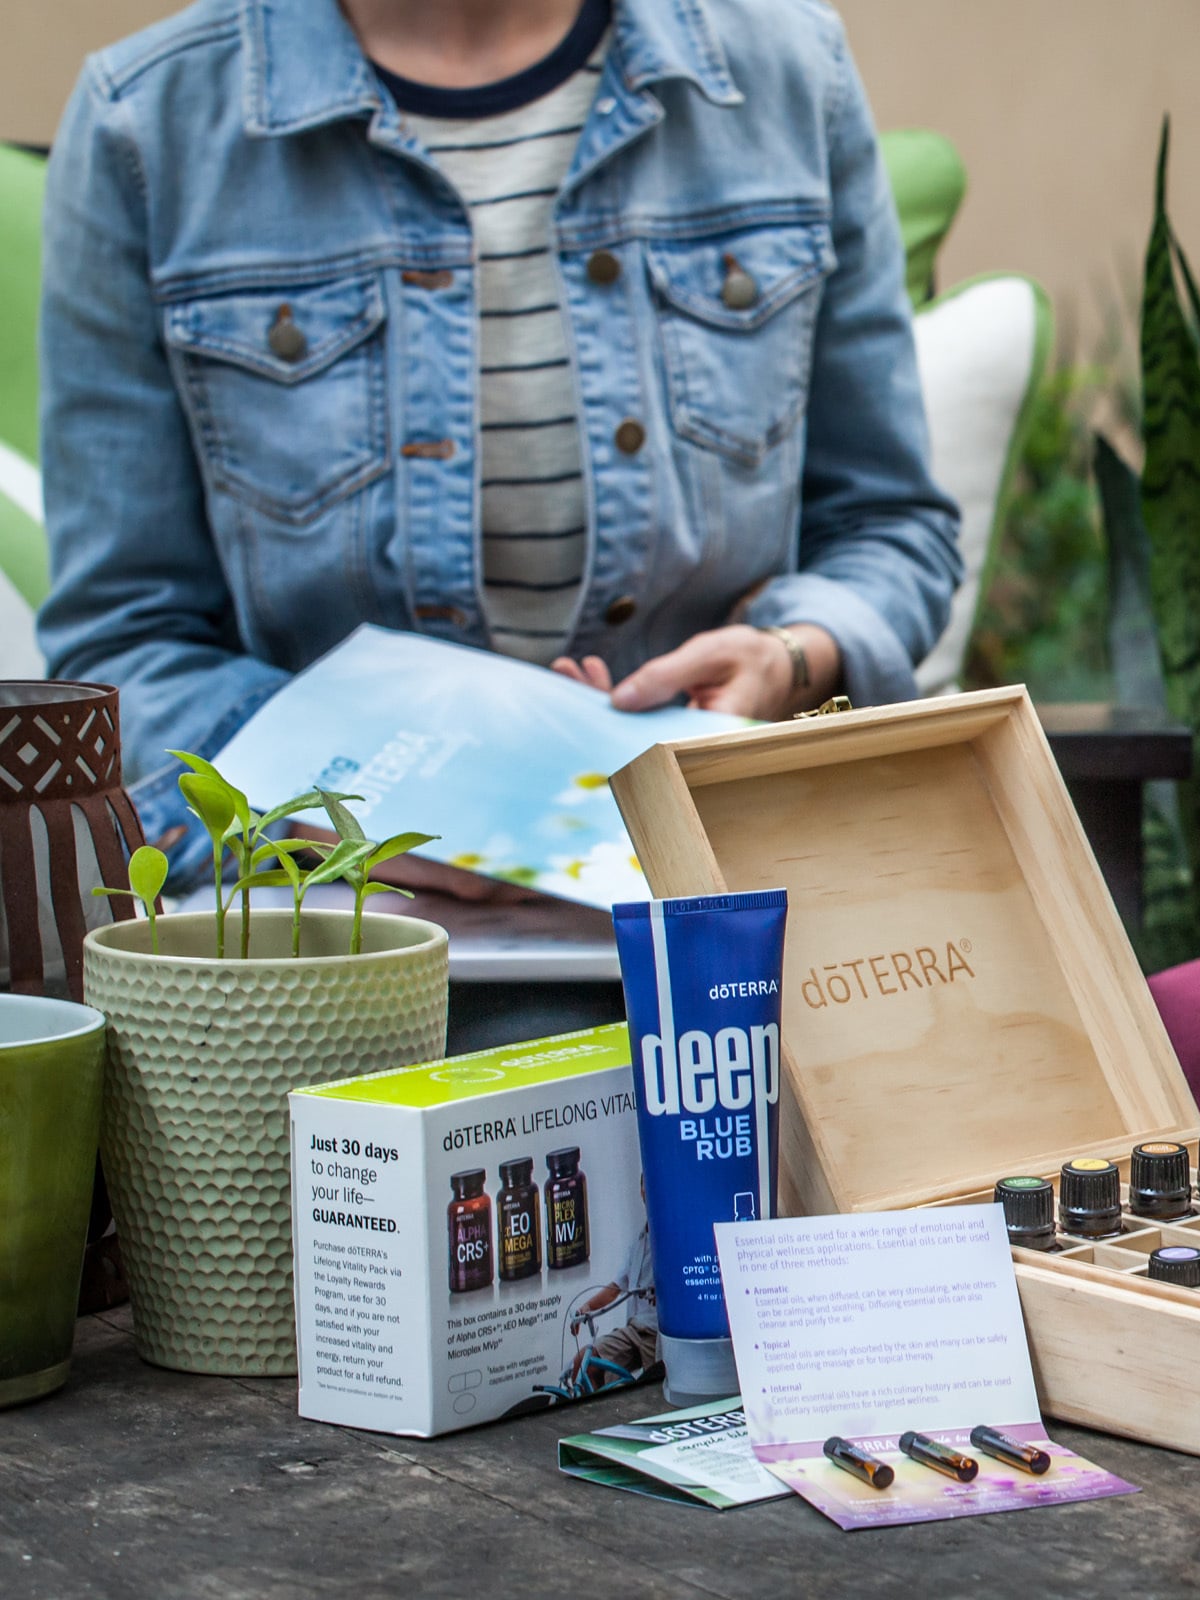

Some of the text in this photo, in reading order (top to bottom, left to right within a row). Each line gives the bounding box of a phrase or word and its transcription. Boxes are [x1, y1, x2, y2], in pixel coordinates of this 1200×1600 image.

[709, 979, 778, 1000] dōTERRA
[641, 1022, 779, 1117] deep
[443, 1117, 516, 1151] dōTERRA
[522, 1100, 598, 1134] LIFELONG
[680, 1114, 751, 1141] BLUE
[310, 1134, 399, 1164] Just 30 days
[696, 1136, 752, 1161] RUB
[311, 1159, 377, 1186] to change
[311, 1185, 340, 1202] your
[553, 1200, 575, 1212] MICRO
[554, 1209, 576, 1223] PLEX
[312, 1208, 401, 1234] GUARANTEED.
[457, 1224, 486, 1243] ALPHA
[735, 1218, 985, 1247] Essential oils are used for a wide range of emotional and
[313, 1239, 346, 1252] Purchase
[457, 1240, 489, 1263] CRS+
[504, 1235, 533, 1253] MEGA
[737, 1231, 990, 1261] physical wellness applications. Essential oils can be used
[313, 1255, 402, 1277] Lifelong Vitality Pack via
[694, 1255, 712, 1263] with
[739, 1256, 849, 1273] in one of three methods:
[314, 1271, 386, 1291] the Loyalty Rewards
[753, 1284, 789, 1295] Aromatic
[314, 1286, 387, 1306] Program, use for 30
[697, 1293, 703, 1301] 4
[755, 1296, 789, 1307] Essential
[807, 1293, 828, 1303] when
[862, 1290, 876, 1299] can
[876, 1288, 887, 1297] be
[888, 1289, 904, 1298] very
[951, 1281, 971, 1291] while
[973, 1279, 997, 1290] others
[314, 1303, 400, 1324] days, and if you are not
[447, 1319, 462, 1330] This
[463, 1317, 477, 1326] box
[477, 1308, 507, 1323] contains
[515, 1300, 538, 1314] 30-day
[539, 1294, 562, 1308] supply
[756, 1309, 771, 1318] can
[773, 1307, 782, 1317] be
[784, 1305, 815, 1316] calming
[816, 1303, 830, 1314] and
[868, 1299, 902, 1310] Diffusing
[903, 1296, 936, 1307] essential
[937, 1295, 951, 1305] oils
[952, 1294, 966, 1304] can
[967, 1292, 983, 1302] also
[315, 1319, 380, 1337] satisfied with your
[447, 1335, 455, 1345] of
[456, 1330, 477, 1342] Alpha
[544, 1310, 558, 1321] and
[315, 1334, 393, 1354] increased vitality and
[447, 1345, 481, 1360] Microplex
[762, 1339, 791, 1351] Topical
[764, 1333, 1008, 1362] Essential oils are easily absorbed by the skin and many can be safely
[316, 1350, 384, 1368] energy, return your
[316, 1366, 343, 1378] product
[344, 1369, 354, 1379] for
[362, 1372, 374, 1382] full
[375, 1375, 404, 1387] refund.
[770, 1383, 802, 1393] Internal
[771, 1394, 800, 1405] Certain
[801, 1391, 835, 1402] essential
[836, 1390, 850, 1400] oils
[851, 1389, 869, 1398] have
[878, 1386, 893, 1395] rich
[893, 1383, 924, 1394] culinary
[925, 1382, 951, 1393] history
[952, 1380, 966, 1390] and
[968, 1380, 982, 1388] can
[983, 1377, 992, 1386] be
[994, 1376, 1012, 1386] used
[676, 1436, 727, 1452] sample
